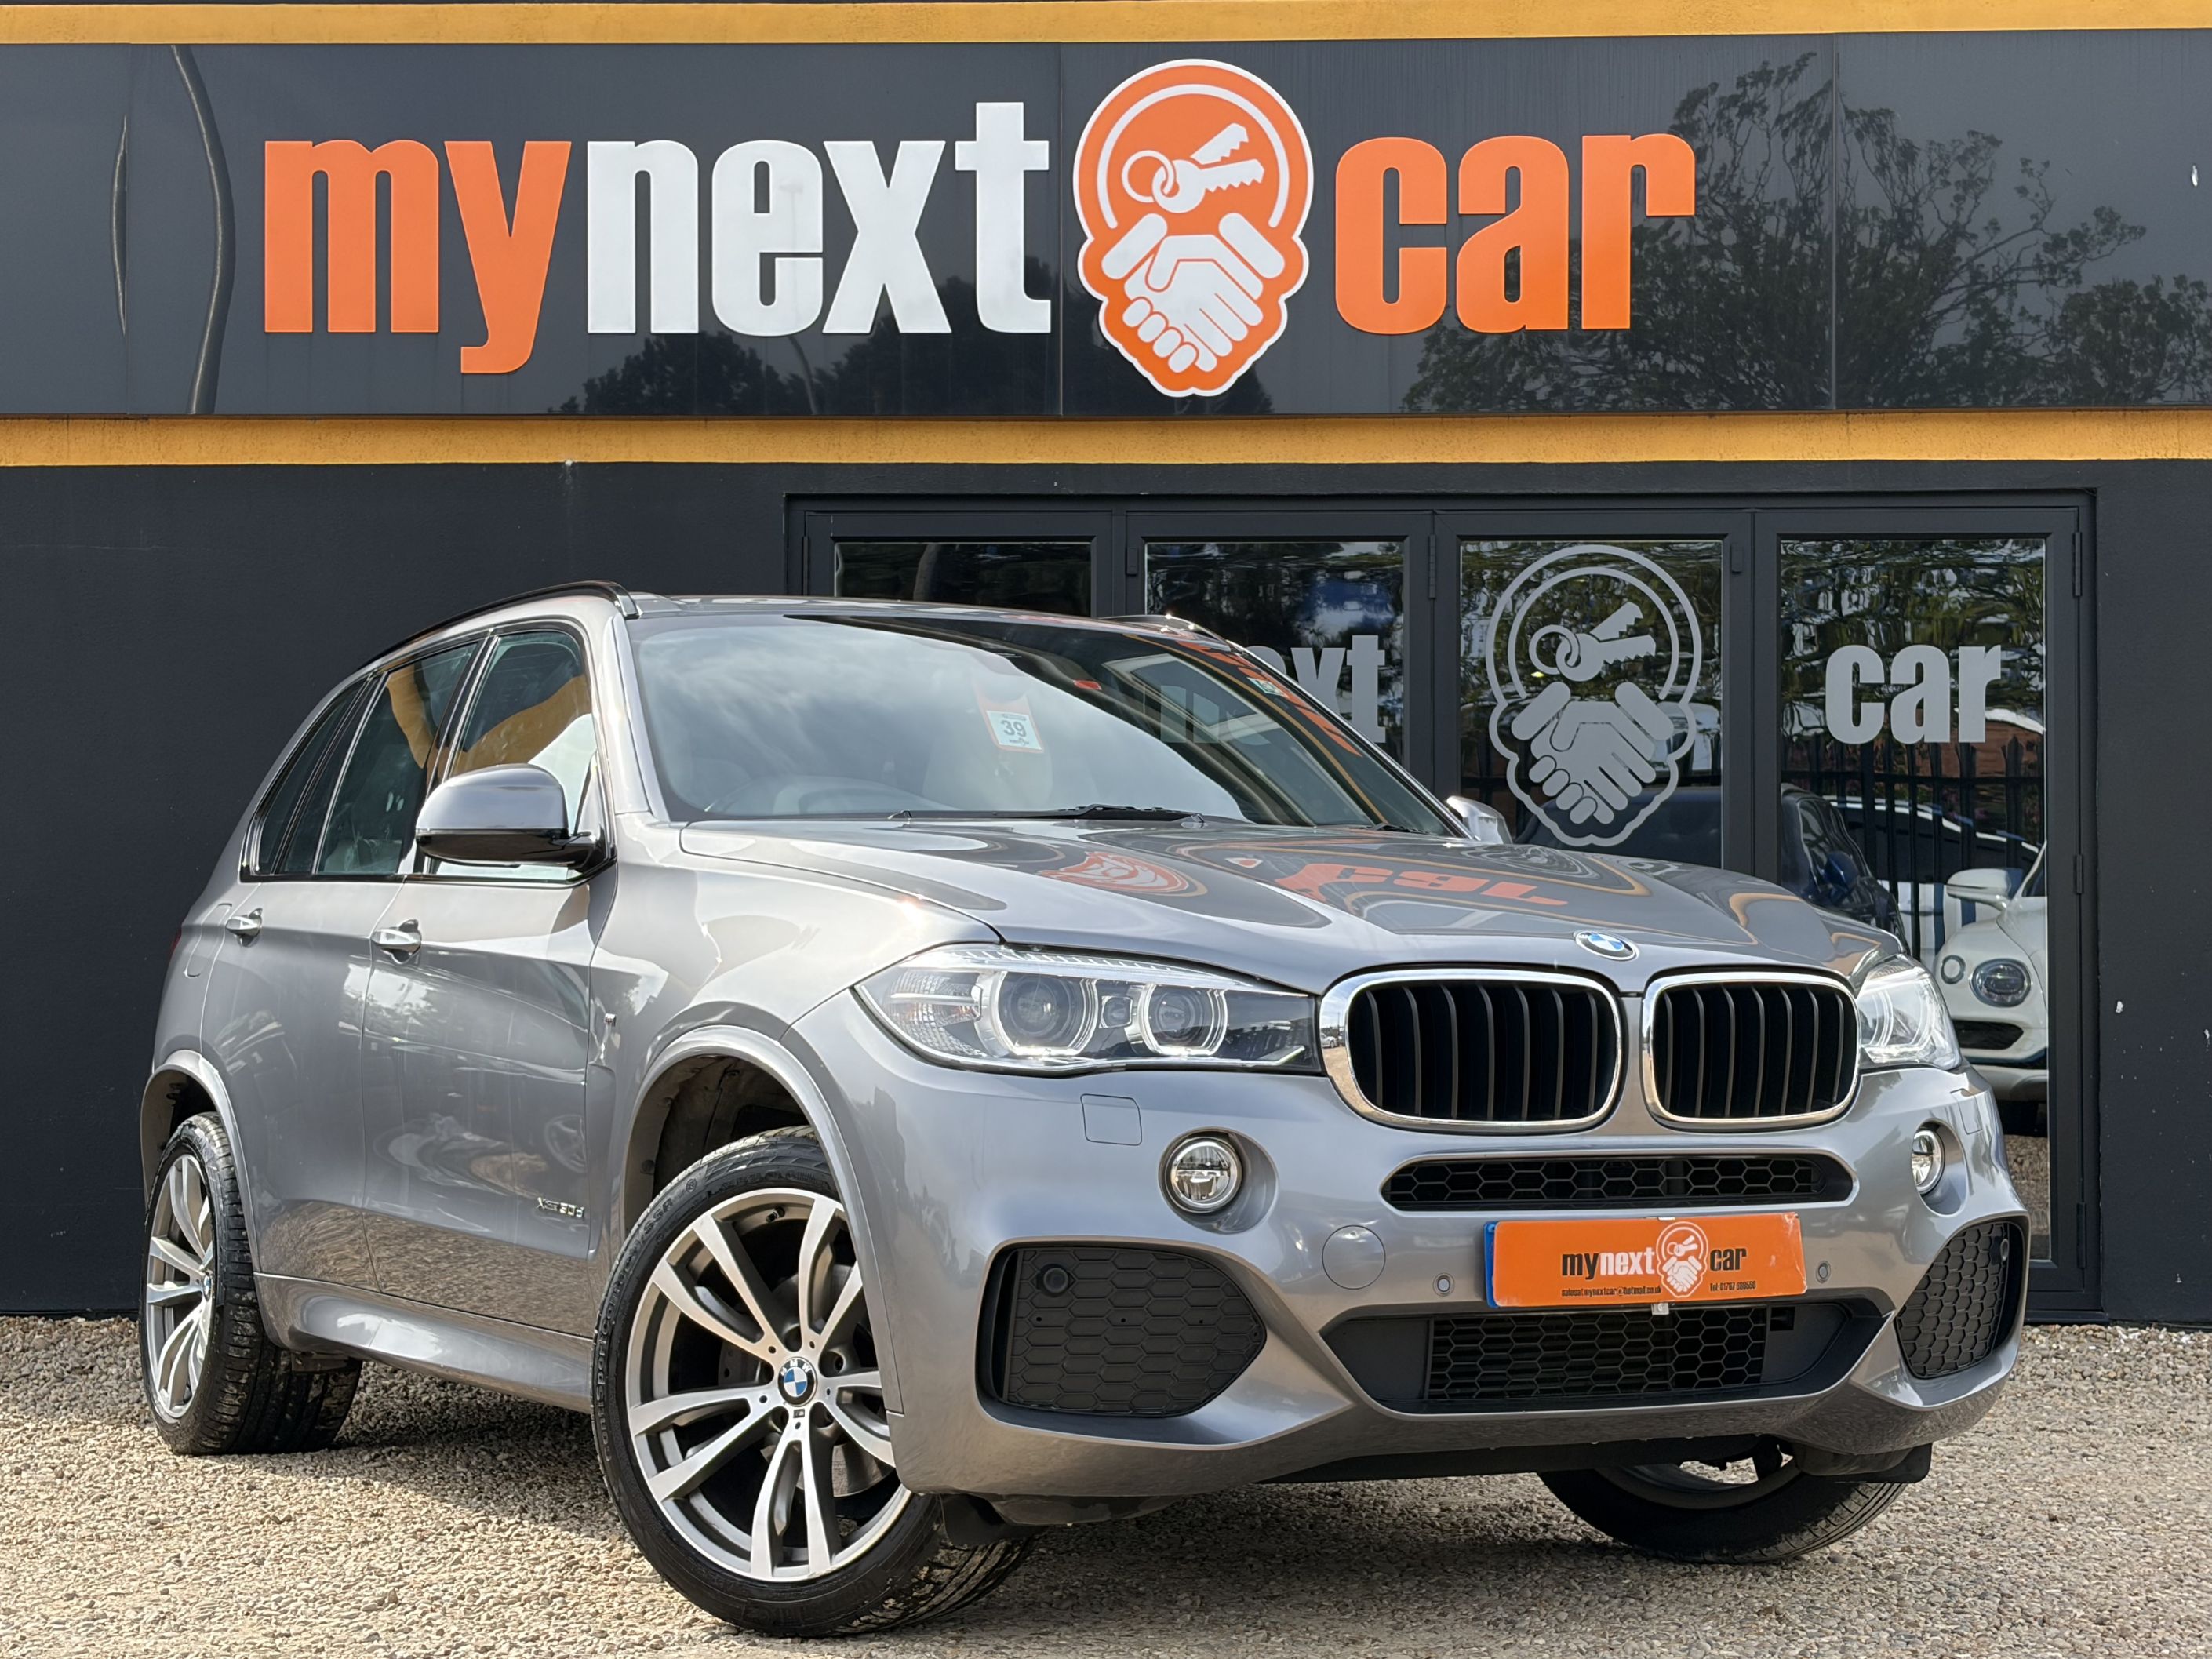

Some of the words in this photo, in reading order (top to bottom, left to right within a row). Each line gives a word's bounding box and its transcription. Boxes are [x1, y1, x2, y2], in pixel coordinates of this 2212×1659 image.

[1335, 134, 1695, 333] car
[1825, 644, 2002, 745] car
[1000, 719, 1027, 737] 39
[1710, 1248, 1748, 1271] car
